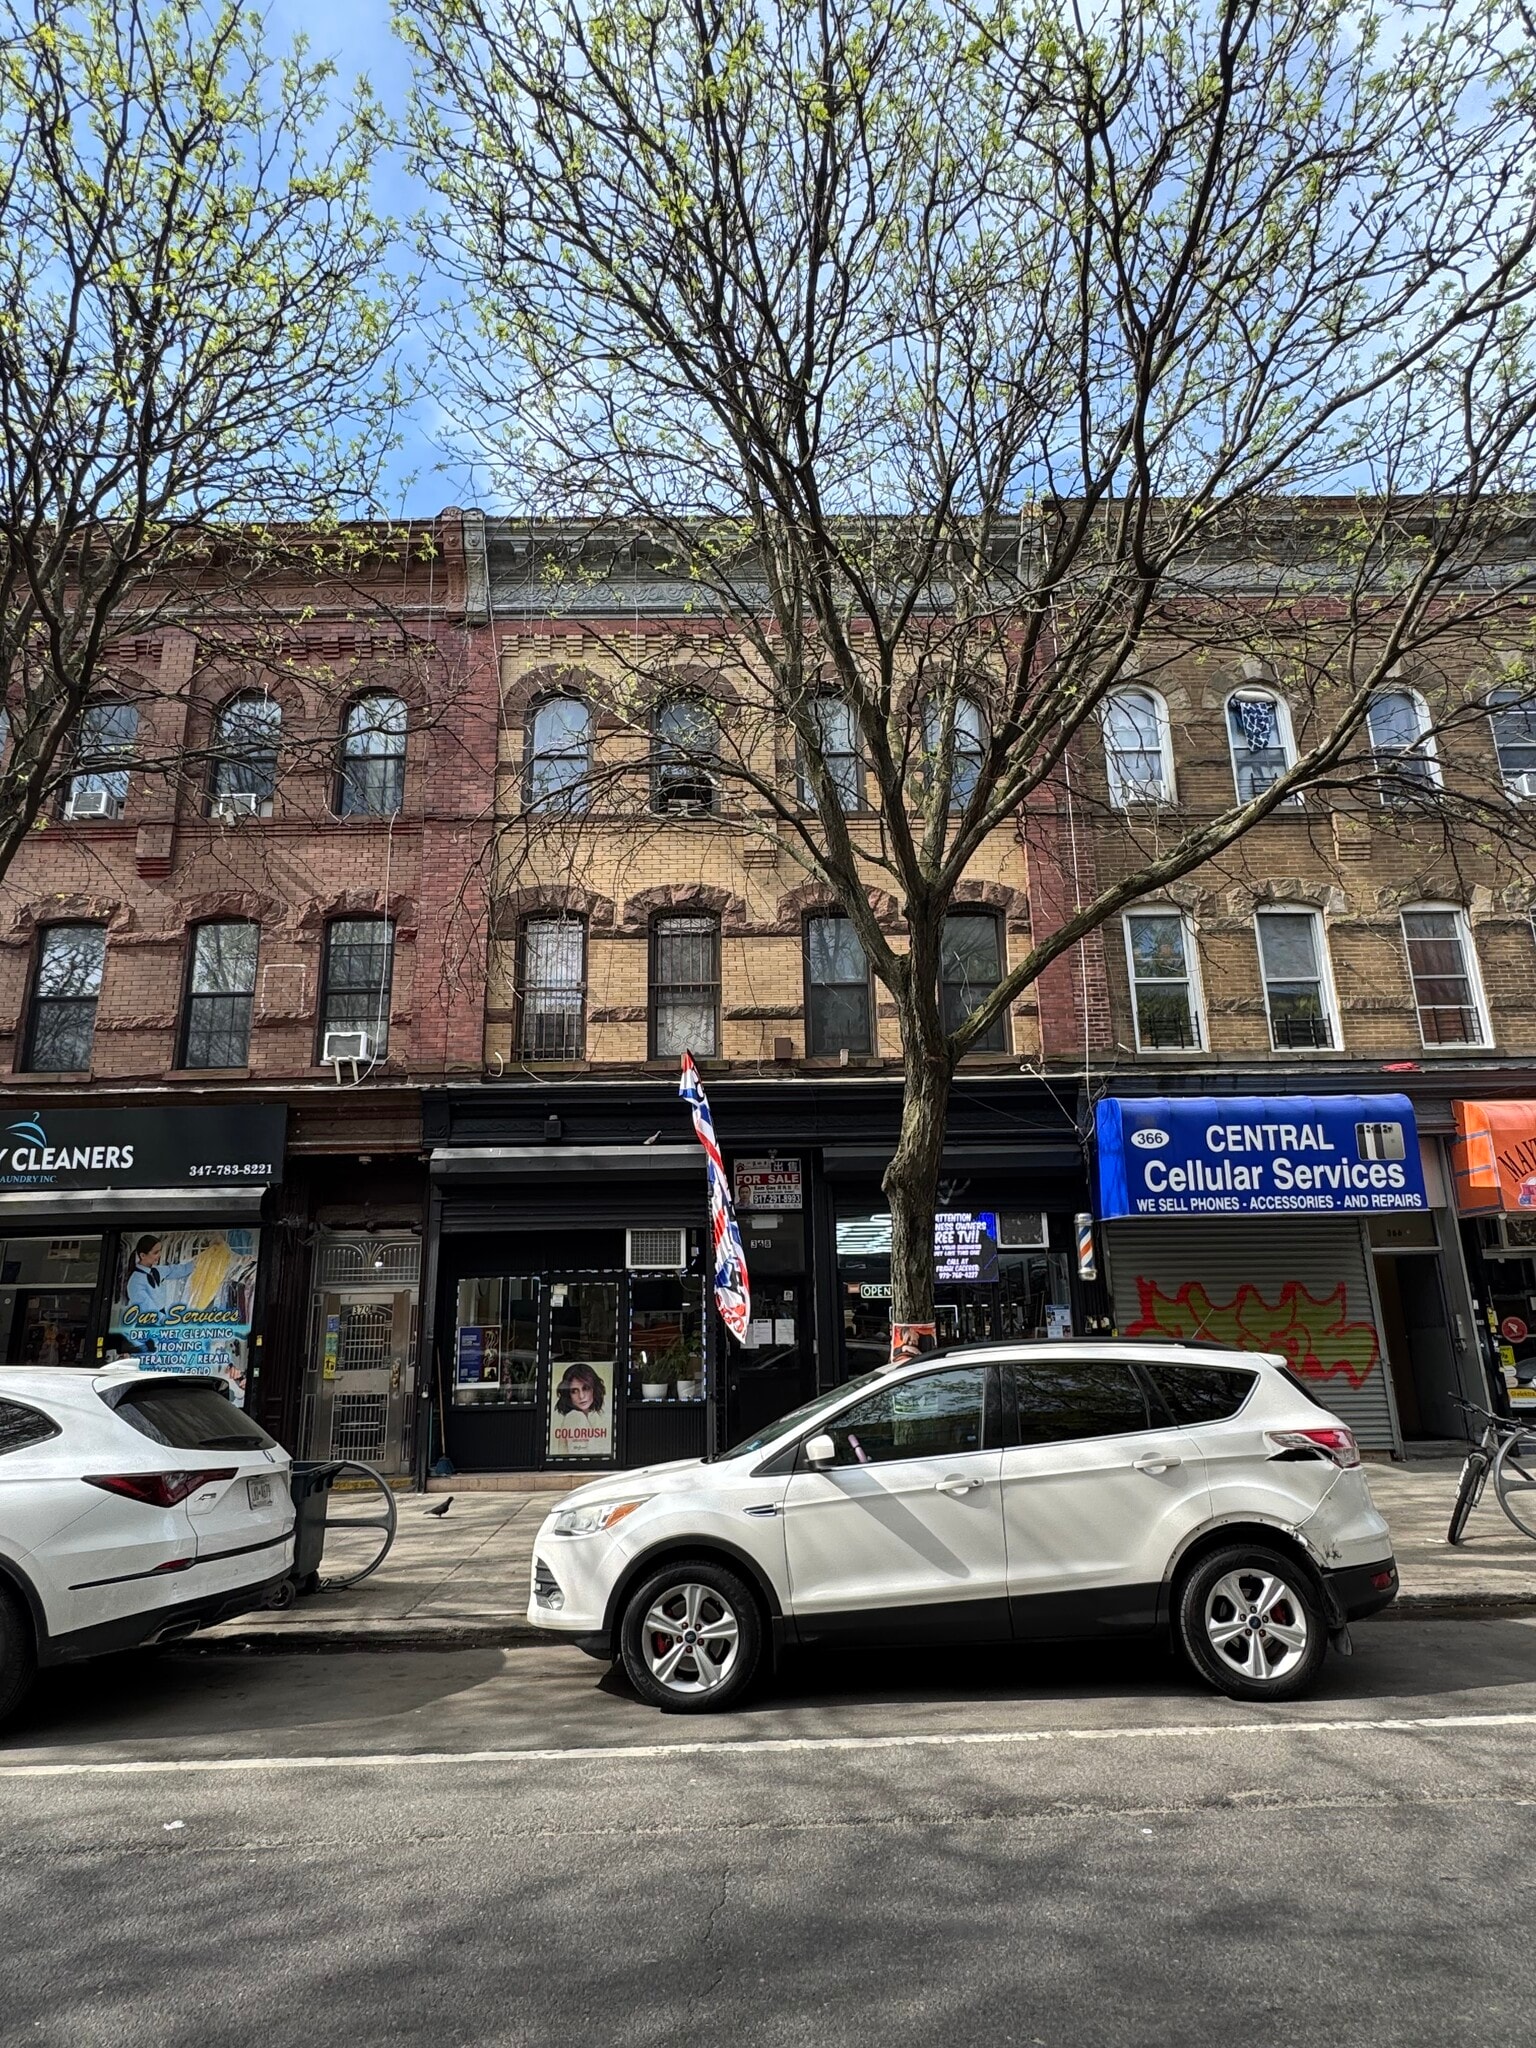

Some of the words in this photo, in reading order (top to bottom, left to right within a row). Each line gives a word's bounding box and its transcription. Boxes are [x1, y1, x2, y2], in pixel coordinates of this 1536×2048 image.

[1137, 1133, 1163, 1144] 366
[1206, 1124, 1335, 1152] CENTRAL
[11, 1145, 134, 1171] CLEANERS
[1497, 1137, 1536, 1183] MAY
[189, 1164, 272, 1176] 347-783-8221
[1144, 1159, 1263, 1192] Cellular
[1272, 1157, 1405, 1190] Services
[0, 1175, 39, 1183] AUNDRY
[736, 1175, 761, 1185] FOR
[767, 1174, 799, 1184] SALE
[1137, 1199, 1156, 1212] WE
[1158, 1198, 1188, 1211] SELL
[1190, 1197, 1239, 1211] PHONES
[1250, 1195, 1334, 1210] ACCESSORIES
[1344, 1194, 1368, 1208] AND
[1371, 1193, 1422, 1208] REPAIRS
[935, 1222, 954, 1231] NESS
[955, 1221, 986, 1230] OWNERS
[935, 1231, 955, 1244] REE
[957, 1230, 979, 1243] TV!!
[863, 1286, 891, 1296] OPEN
[124, 1305, 159, 1325] Our
[165, 1305, 240, 1325] Services
[352, 1304, 372, 1316] 370
[130, 1330, 149, 1340] DRY
[160, 1330, 179, 1339] WET
[182, 1328, 233, 1339] CLEANING
[158, 1342, 202, 1352] IRONING
[140, 1355, 186, 1365] TERATION
[197, 1353, 230, 1364] REPAIR
[555, 1428, 607, 1439] COLORUSH
